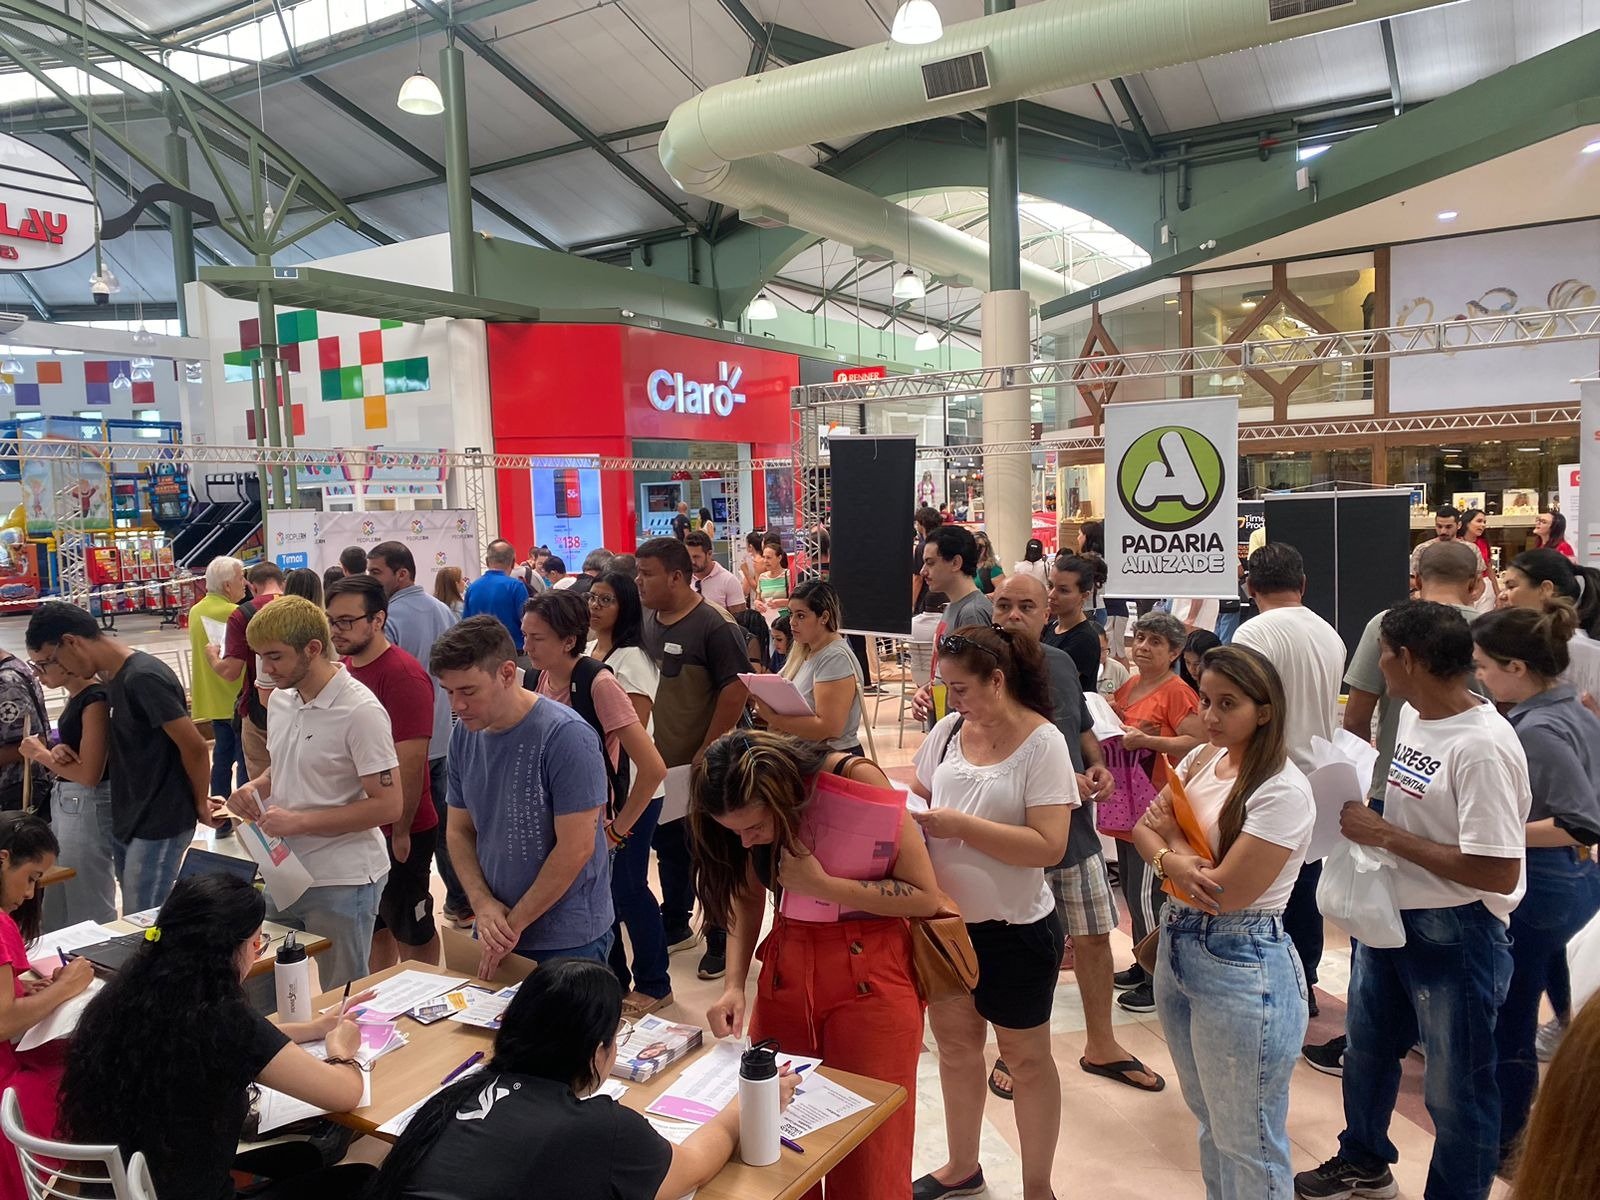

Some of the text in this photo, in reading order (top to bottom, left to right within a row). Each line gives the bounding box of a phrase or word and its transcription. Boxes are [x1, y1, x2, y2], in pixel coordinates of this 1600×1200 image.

[848, 371, 880, 381] RENNER
[647, 367, 737, 417] Claro
[1122, 532, 1225, 554] PADARIA
[1122, 554, 1225, 573] AMIZADE
